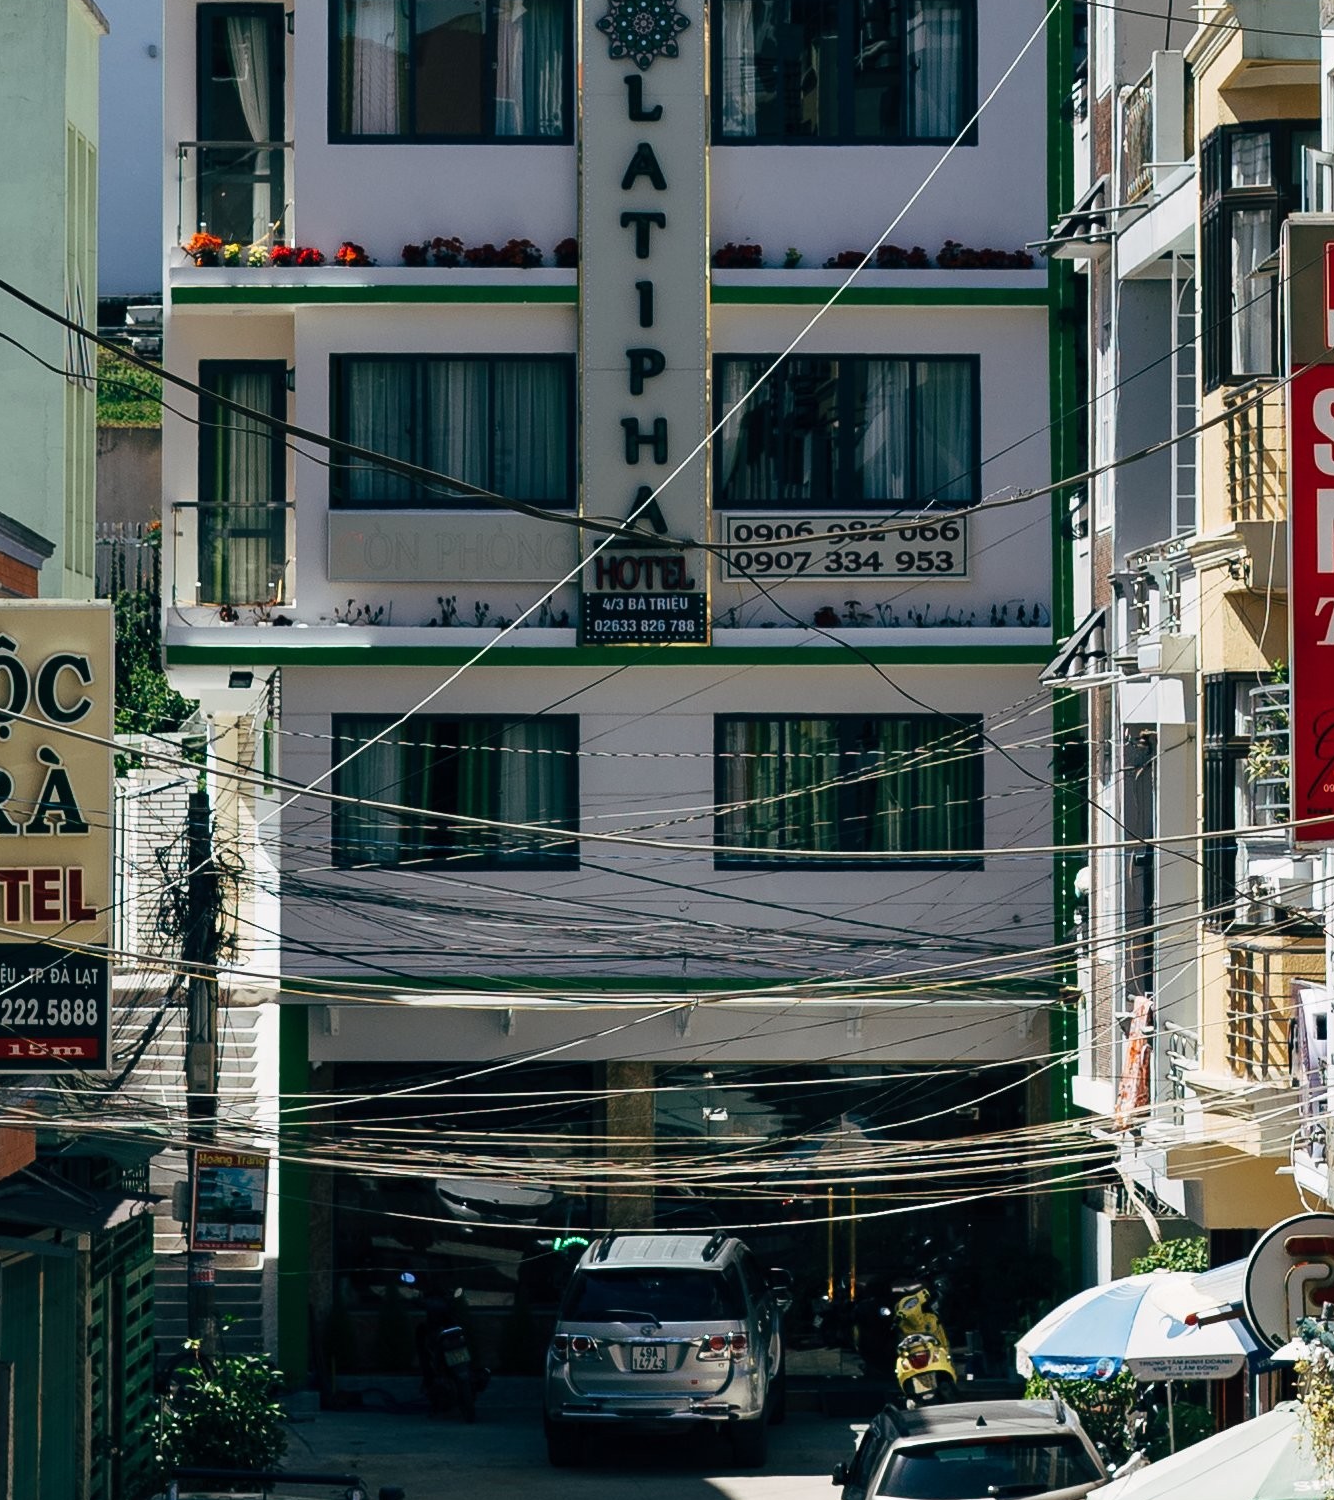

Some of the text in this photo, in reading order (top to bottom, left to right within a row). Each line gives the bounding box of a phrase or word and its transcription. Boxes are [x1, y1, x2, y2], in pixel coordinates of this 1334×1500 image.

[733, 549, 955, 573] 0907 334 953
[593, 556, 696, 591] HOTEL
[602, 597, 624, 611] 4/3
[594, 619, 696, 632] 02633 826 788
[50, 963, 70, 984] ĐÀ
[75, 968, 98, 990] LẠT
[8, 1043, 85, 1056] 15m
